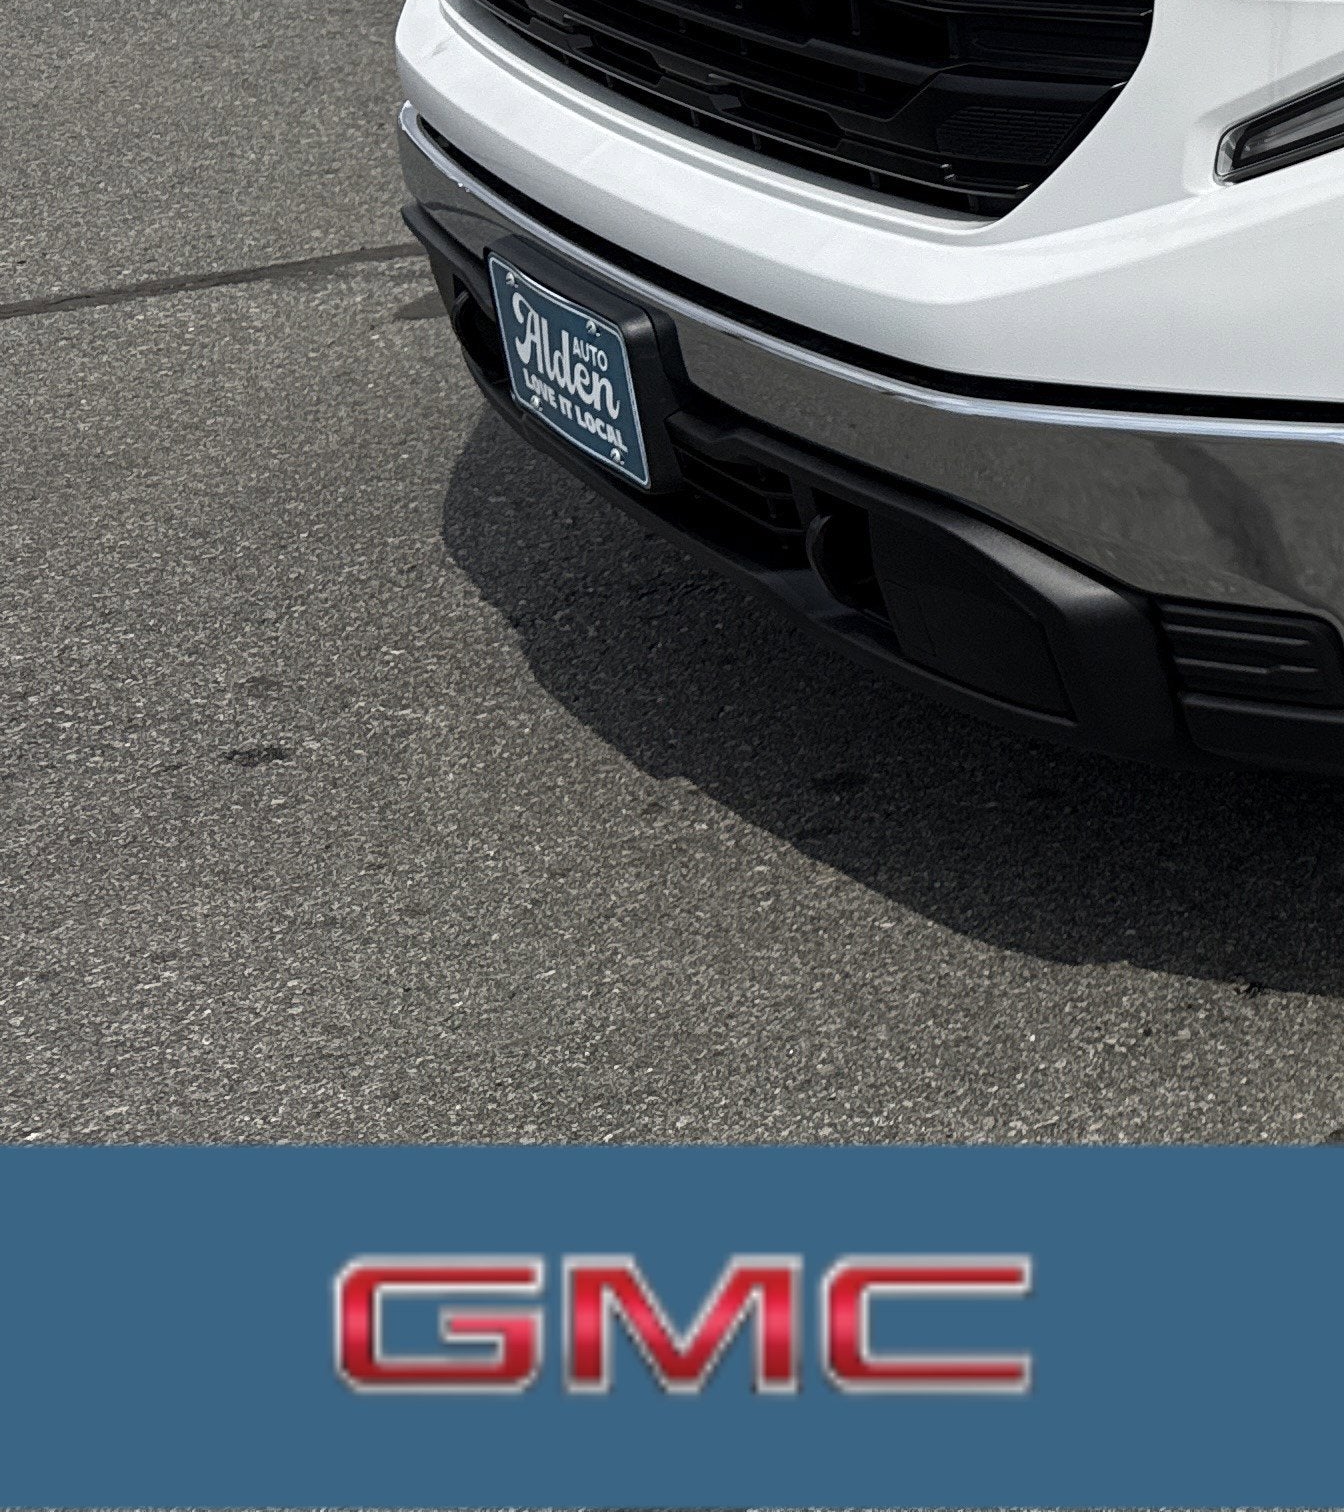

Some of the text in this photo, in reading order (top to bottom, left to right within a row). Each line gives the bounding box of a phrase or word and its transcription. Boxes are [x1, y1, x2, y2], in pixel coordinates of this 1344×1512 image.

[512, 292, 620, 419] Alden
[572, 336, 608, 371] AUTO
[523, 368, 628, 453] LOVE IT LOCAL
